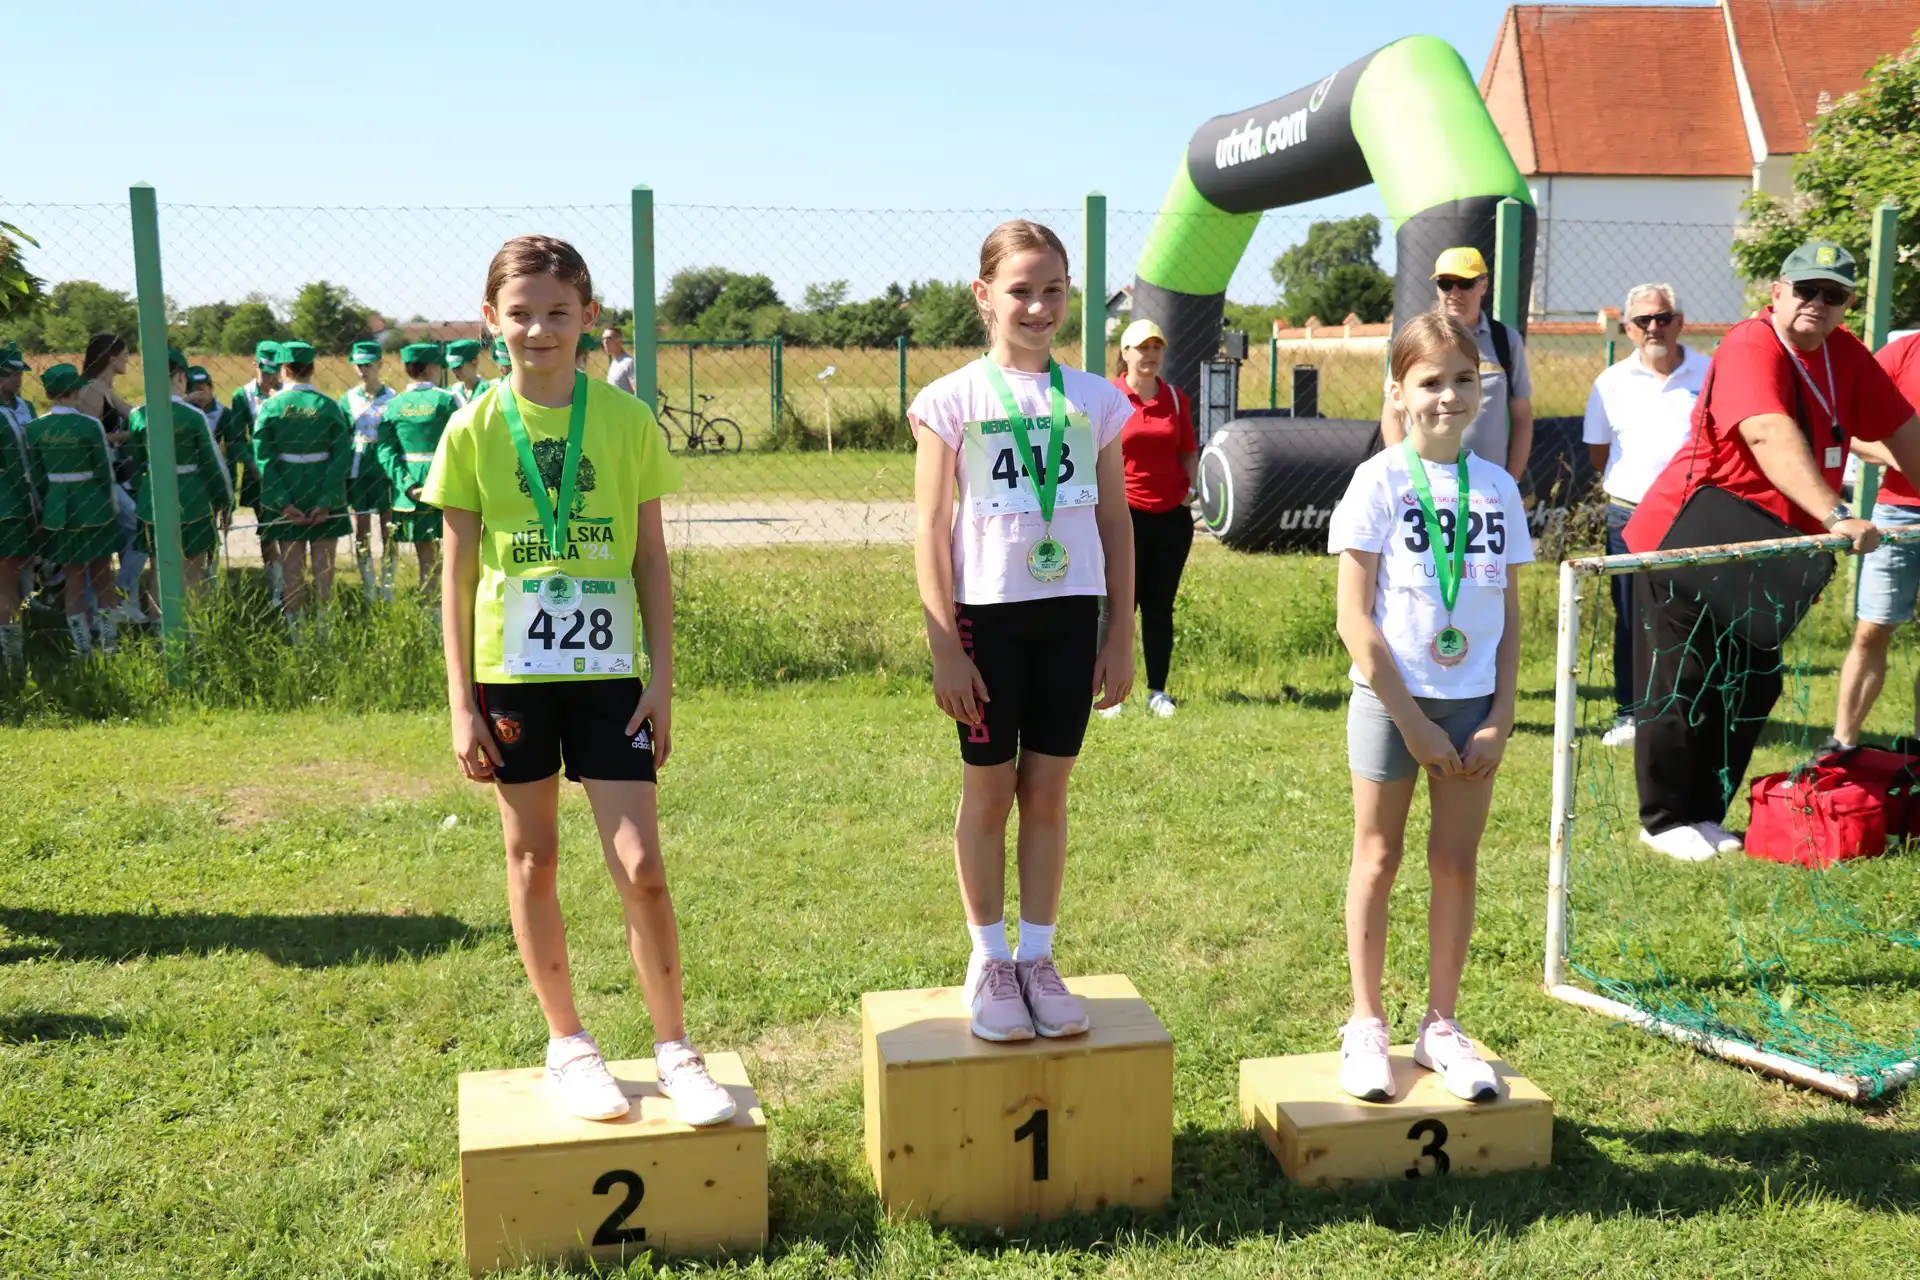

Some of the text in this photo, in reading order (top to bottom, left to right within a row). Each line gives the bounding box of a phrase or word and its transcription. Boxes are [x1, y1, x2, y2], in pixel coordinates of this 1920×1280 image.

[512, 526, 614, 546] NELSKA
[1279, 501, 1341, 530] utr
[528, 607, 614, 651] 428
[1014, 1109, 1048, 1181] 1
[1405, 1118, 1450, 1180] 3
[592, 1169, 646, 1247] 2
